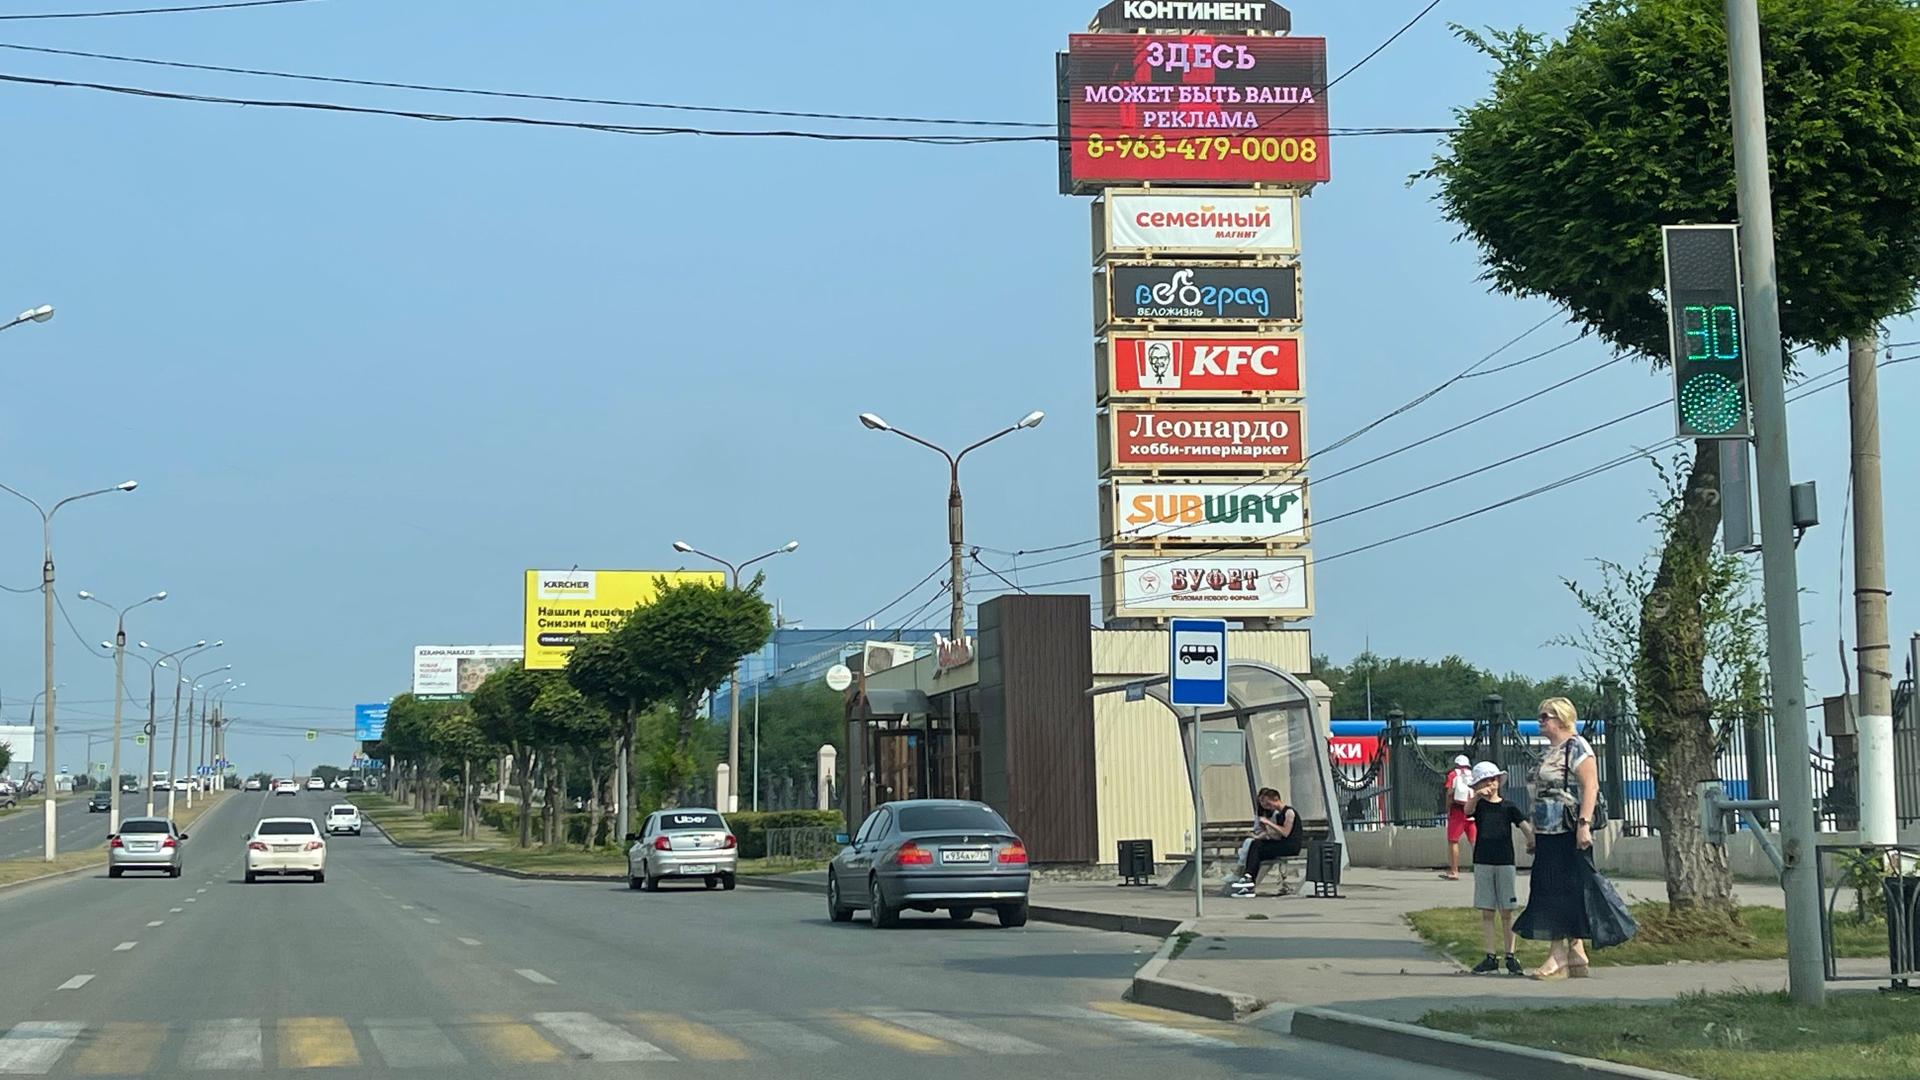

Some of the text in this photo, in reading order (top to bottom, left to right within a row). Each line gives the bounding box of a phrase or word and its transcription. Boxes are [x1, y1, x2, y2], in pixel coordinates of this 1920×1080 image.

[1123, 0, 1266, 21] КОНТИНЕНТ
[1146, 42, 1256, 72] ЗДЕСЬ
[1085, 86, 1315, 104] МОЖЕТ БЫТЬ ВАША
[1143, 111, 1259, 128] РЕКЛАМА
[1087, 134, 1317, 163] 8-963-479-0008
[1137, 308, 1203, 317] ВЕЛОЖИЗНЬ
[1684, 306, 1738, 360] 30
[1189, 346, 1280, 376] KFC
[1129, 414, 1289, 444] Леонардо
[1130, 443, 1289, 458] хобби-гипермаркет
[1125, 493, 1300, 526] SUBWAY
[1171, 568, 1259, 591] БУФЕТ
[538, 607, 633, 618] Нашли дешевл
[538, 618, 586, 629] Снизим
[674, 816, 707, 824] Uber
